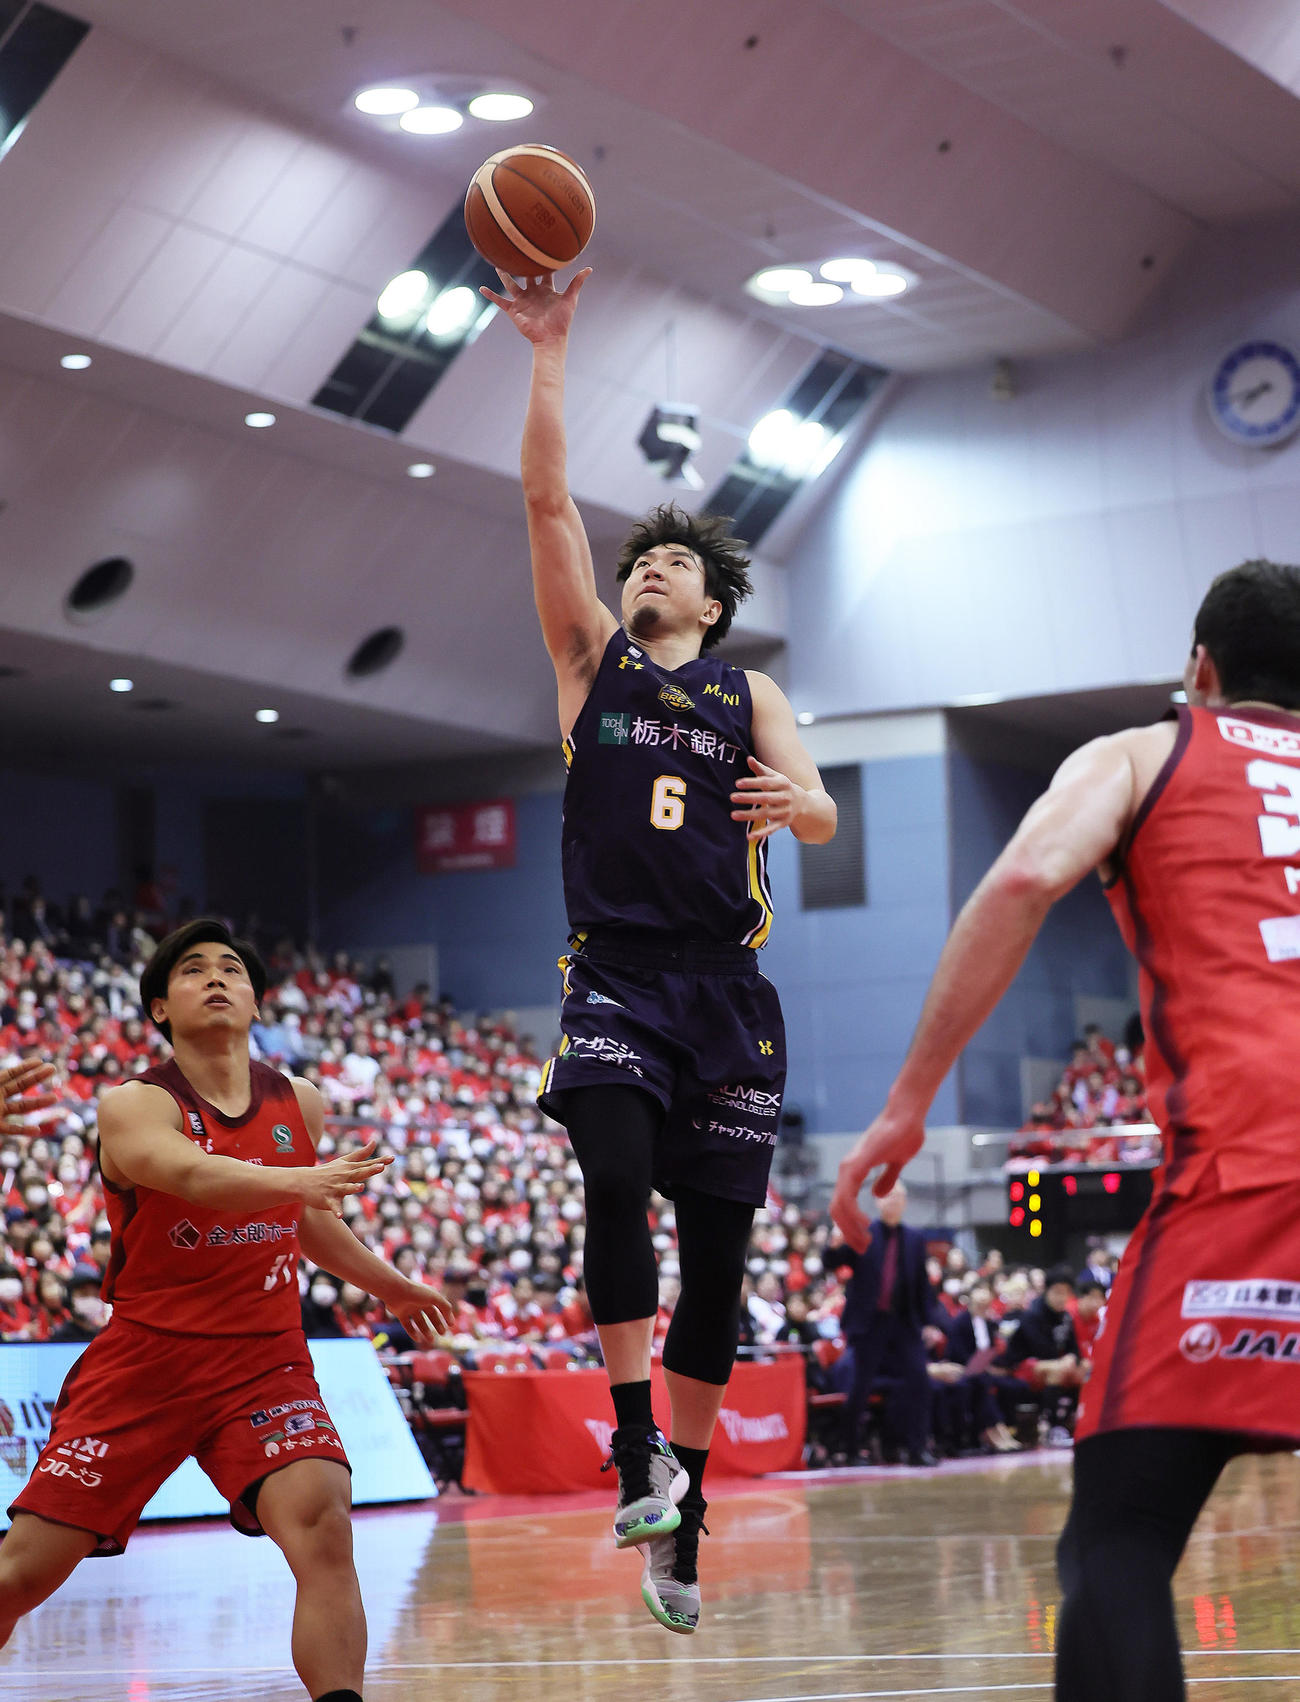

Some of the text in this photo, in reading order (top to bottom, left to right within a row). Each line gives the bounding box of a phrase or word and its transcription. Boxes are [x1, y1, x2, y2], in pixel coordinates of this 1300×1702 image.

[631, 716, 741, 764] 栃木銀行
[650, 775, 687, 831] 6
